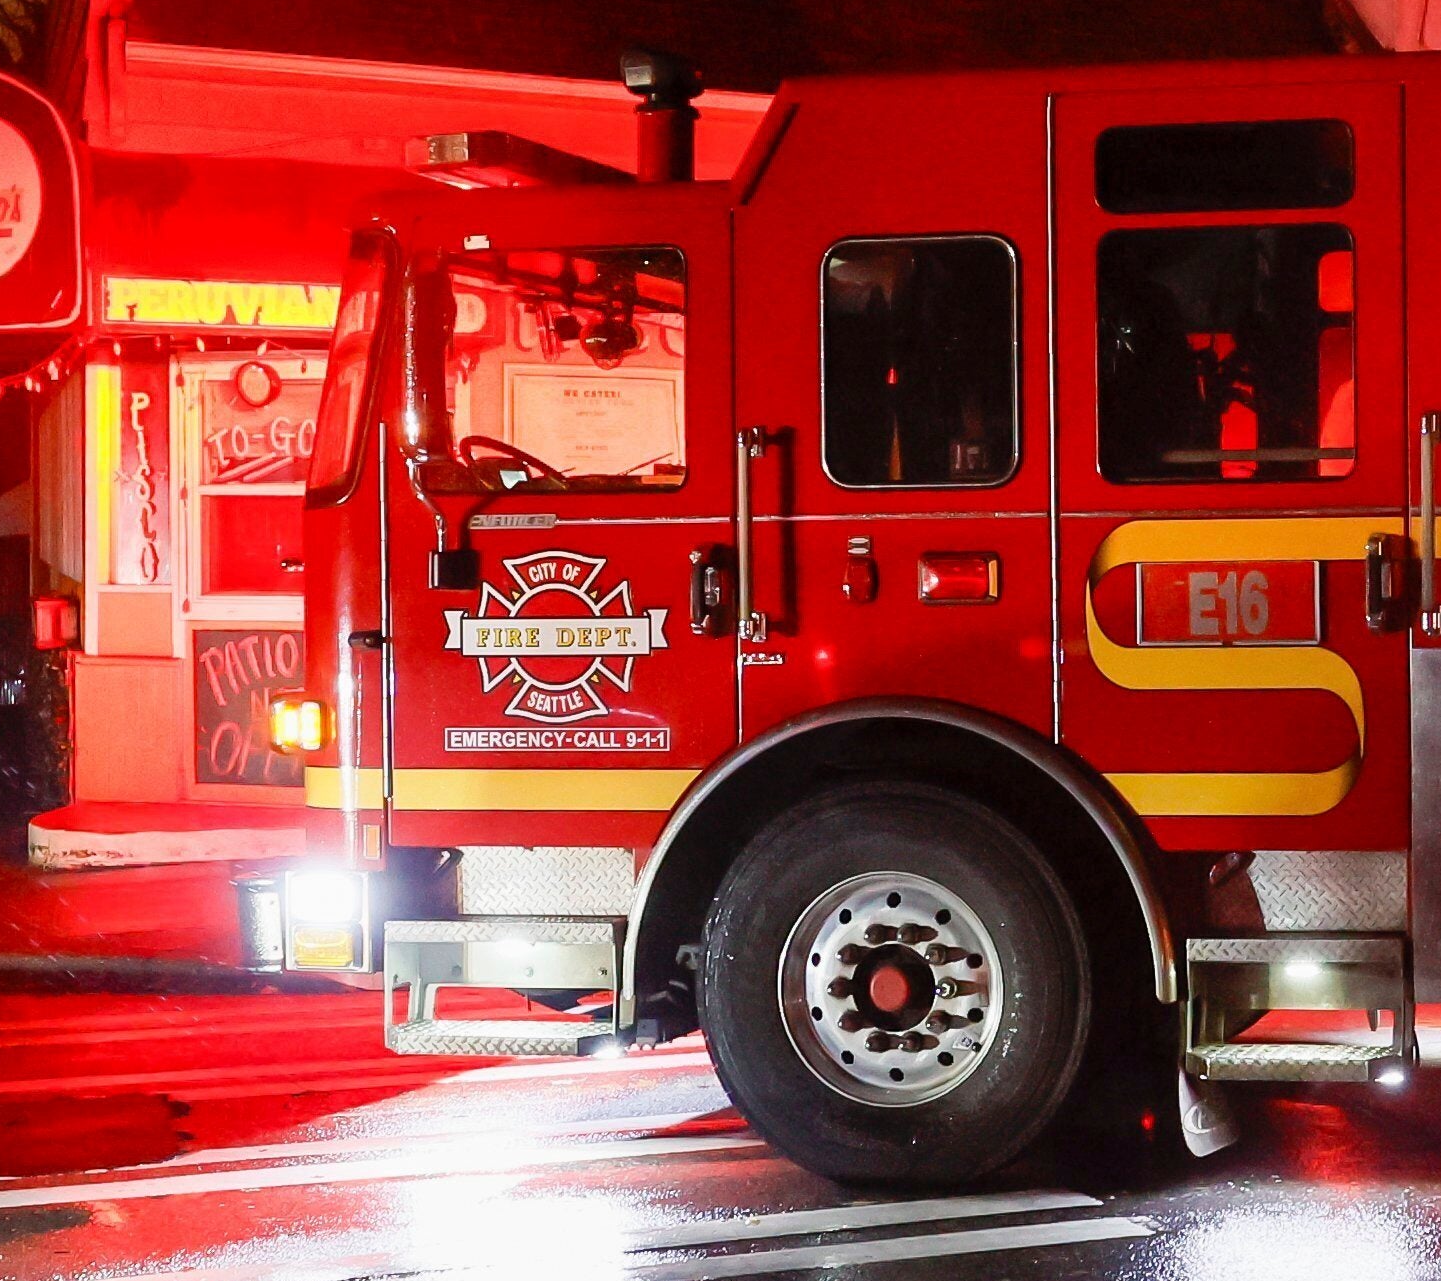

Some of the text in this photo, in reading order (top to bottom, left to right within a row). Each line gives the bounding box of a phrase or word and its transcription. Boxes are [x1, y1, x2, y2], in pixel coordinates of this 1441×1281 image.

[111, 280, 340, 327] PERUVIAN
[528, 562, 581, 583] CITY OF
[1188, 570, 1269, 635] E16
[476, 626, 638, 648] FIRE DEPT.
[199, 634, 299, 706] PATIO
[527, 690, 584, 713] SEATTLE
[450, 731, 665, 749] EMERGENCY-CALL 9-1-1
